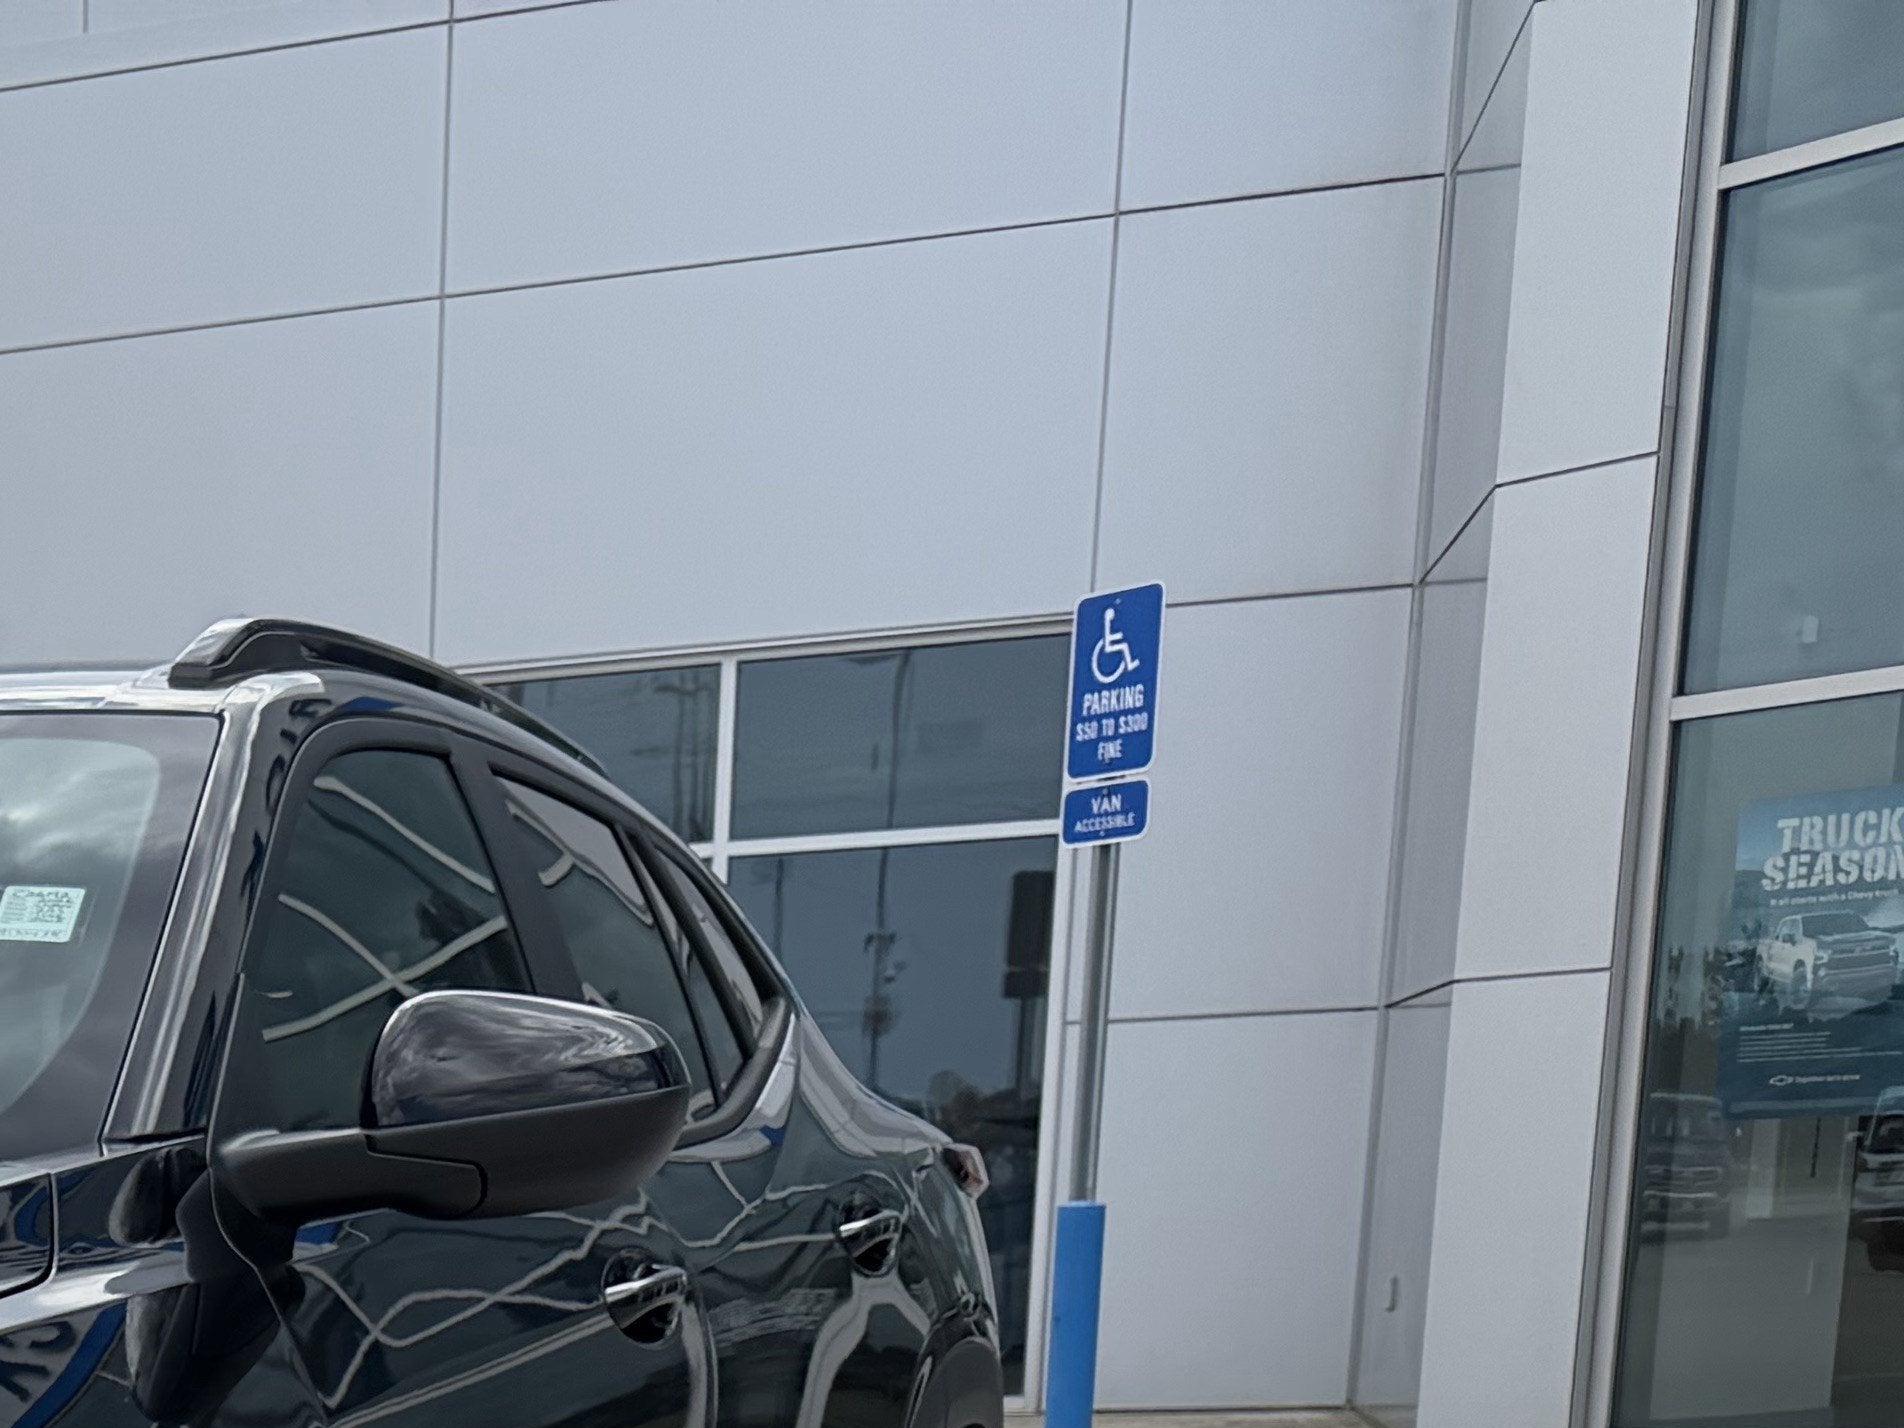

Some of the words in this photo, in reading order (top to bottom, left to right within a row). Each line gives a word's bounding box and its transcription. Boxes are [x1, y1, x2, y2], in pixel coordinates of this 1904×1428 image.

[1082, 684, 1145, 717] PARKING
[1075, 720, 1098, 742] $50
[1102, 718, 1115, 737] TO
[1097, 739, 1123, 760] FINE
[1091, 793, 1122, 814] VAN
[1074, 812, 1136, 833] ACCESSIBLE
[1776, 806, 1904, 854] TRUCK
